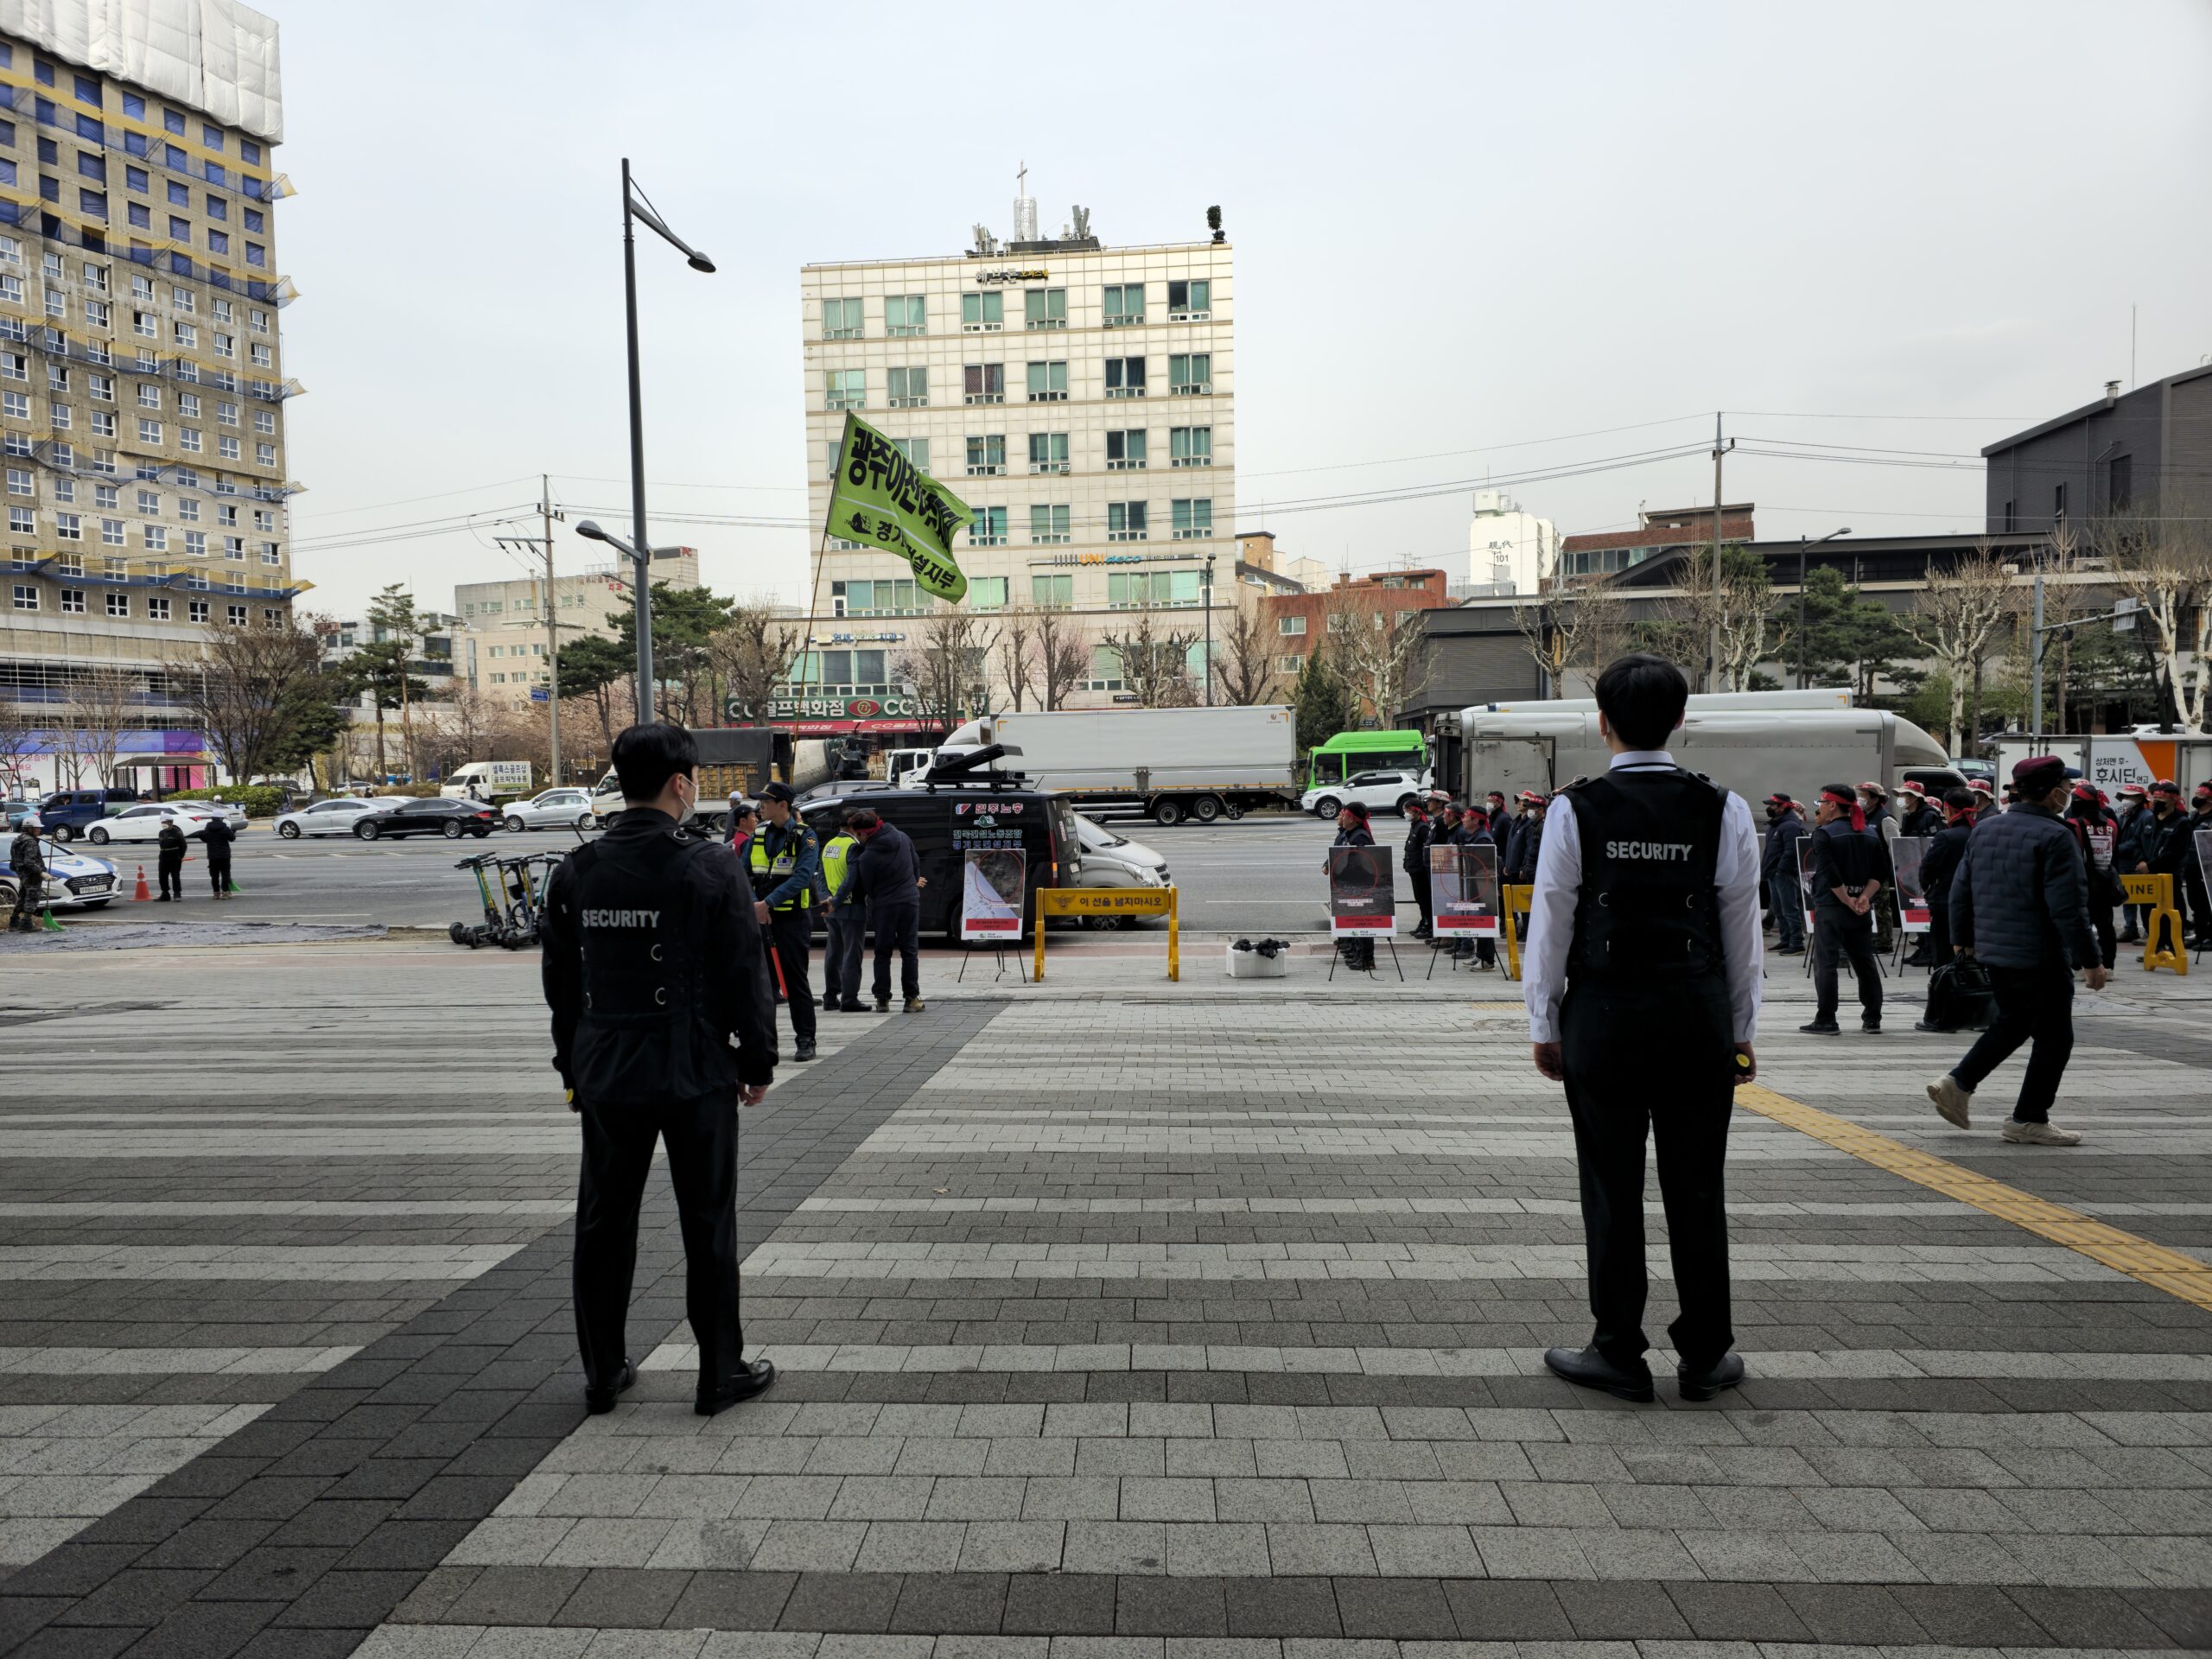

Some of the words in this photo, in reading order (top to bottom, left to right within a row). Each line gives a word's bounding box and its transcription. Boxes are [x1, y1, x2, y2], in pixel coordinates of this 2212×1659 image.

[1496, 554, 1509, 563] 101
[2095, 757, 2117, 766] 상처엔
[2095, 768, 2136, 785] 후시딘
[2136, 776, 2149, 785] 연고
[975, 803, 1024, 815] 민주노총
[953, 829, 1023, 840] 전국건설노동조합
[953, 840, 1022, 850] 경기도건설지부
[1605, 841, 1694, 861] SECURITY
[2123, 884, 2154, 895] INE
[1079, 897, 1089, 907] 이
[1092, 897, 1111, 907] 선을
[1115, 896, 1162, 907] 넘지마시오
[582, 909, 661, 929] SECURITY
